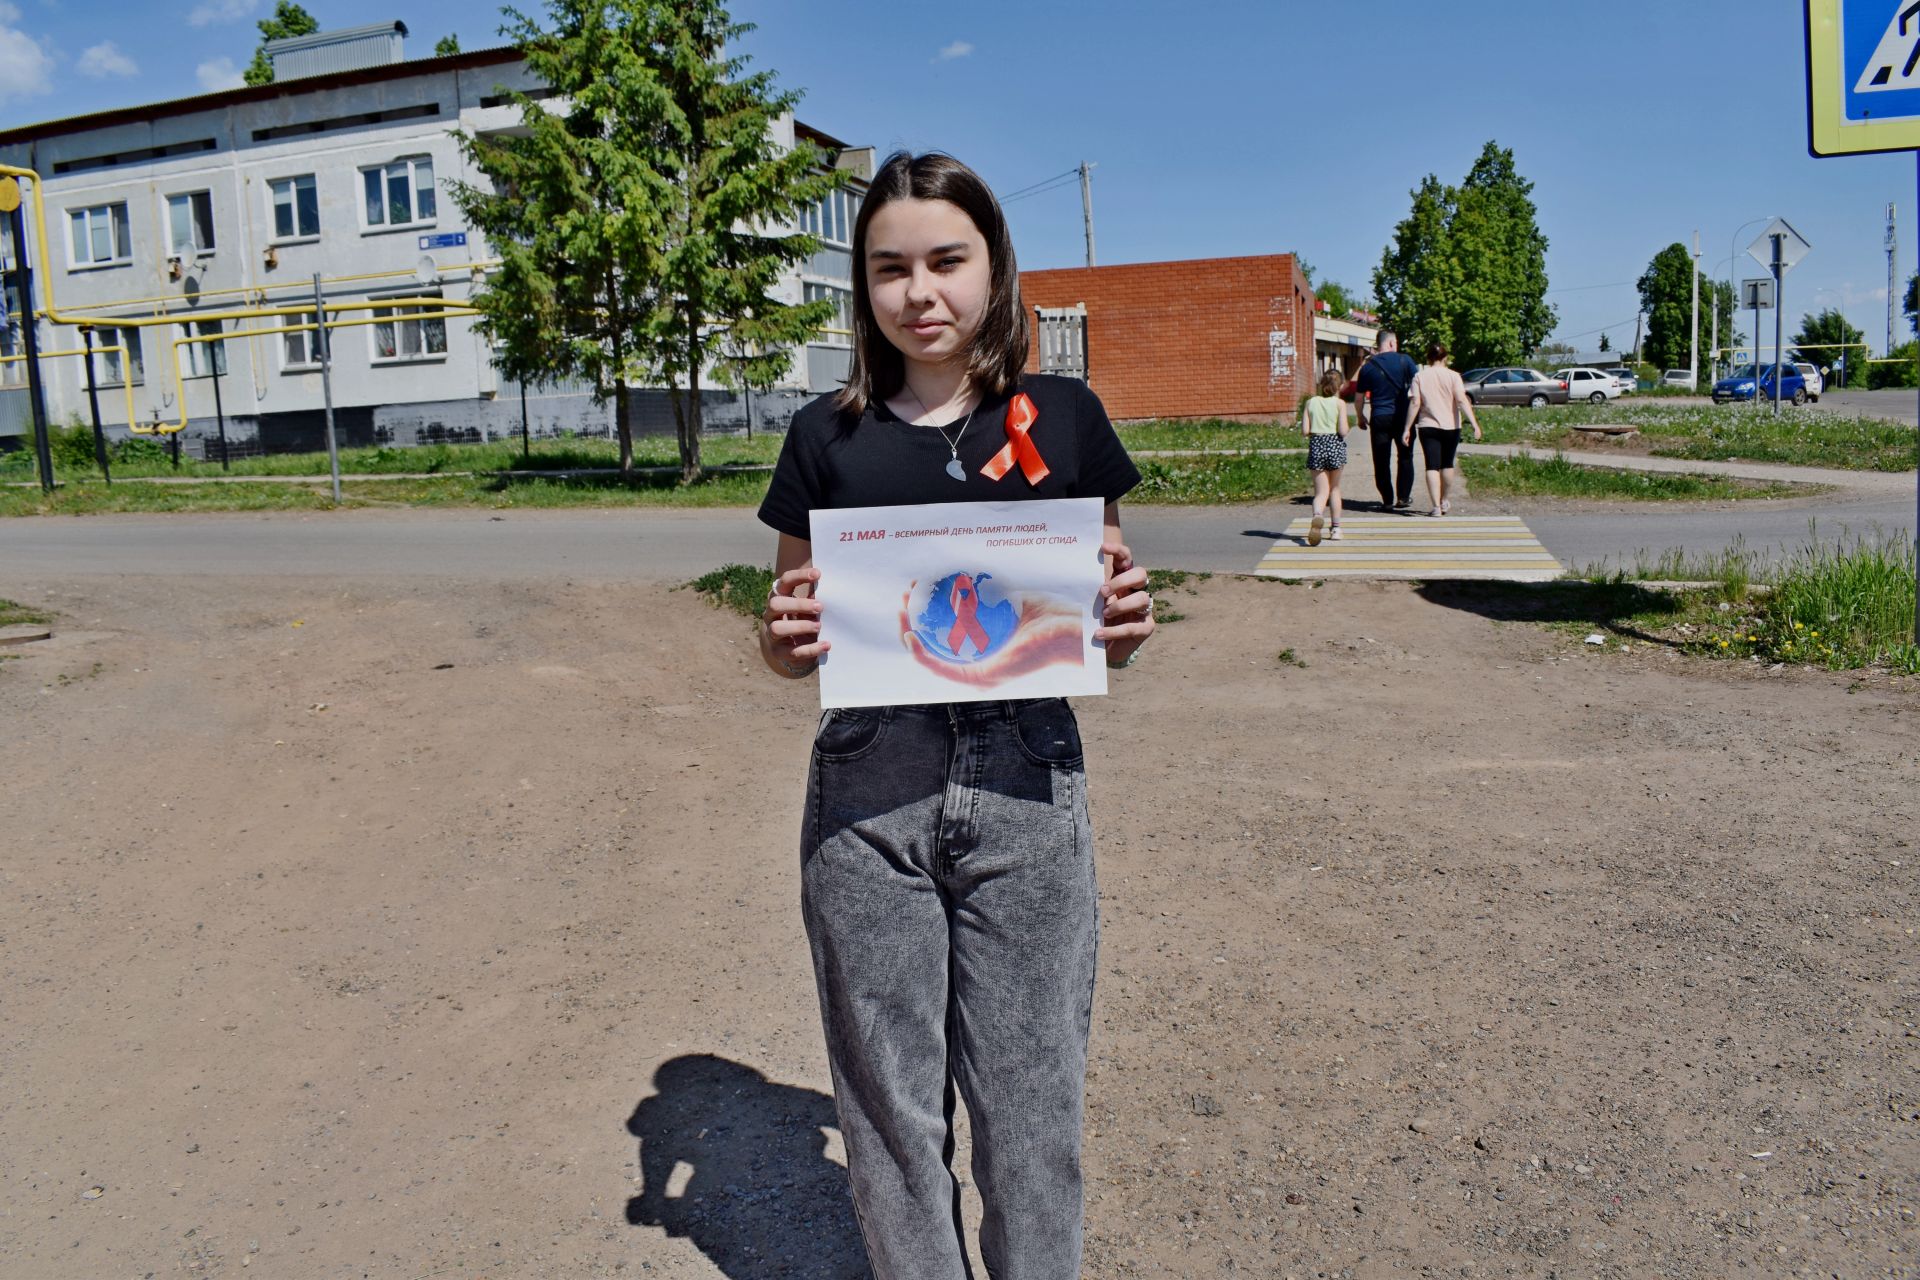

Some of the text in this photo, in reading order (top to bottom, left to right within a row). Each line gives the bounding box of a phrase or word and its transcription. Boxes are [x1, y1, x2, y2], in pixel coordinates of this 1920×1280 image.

[839, 531, 854, 542] 21
[857, 529, 886, 541] МАЯ
[894, 526, 950, 539] ВСЕМИРНЫЙ
[950, 526, 974, 537] ДЕНЬ
[975, 525, 1012, 534] ПАМЯТИ
[1014, 522, 1048, 534] ЛЮДЕЙ,
[986, 535, 1078, 548] ПОГИБШИХ ОТ СПИДА
